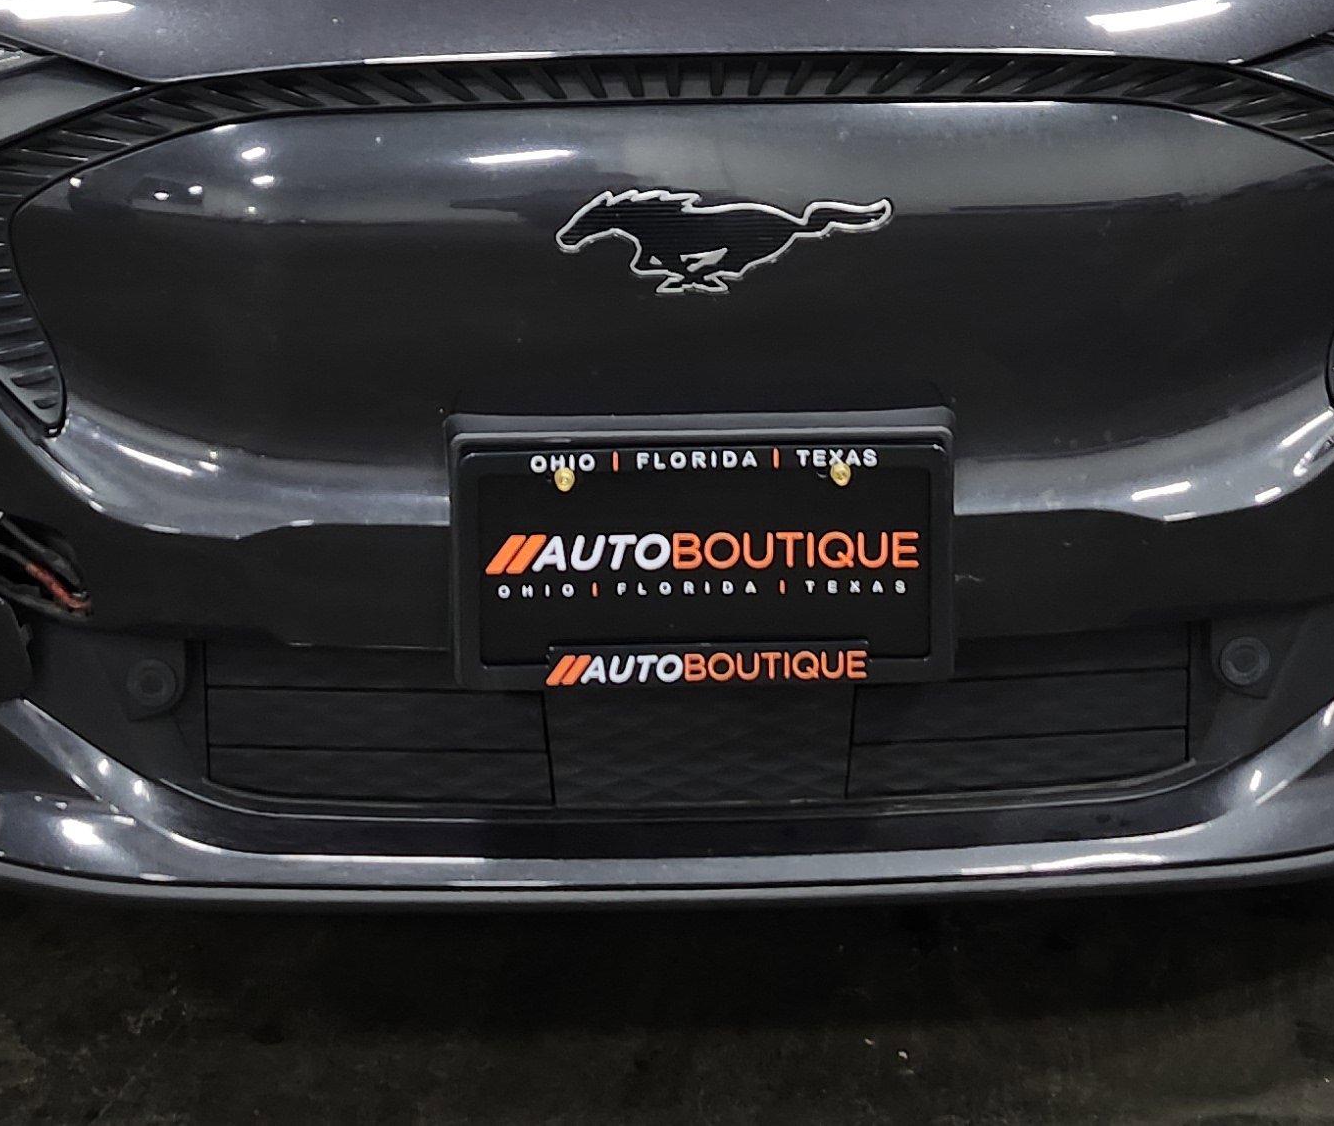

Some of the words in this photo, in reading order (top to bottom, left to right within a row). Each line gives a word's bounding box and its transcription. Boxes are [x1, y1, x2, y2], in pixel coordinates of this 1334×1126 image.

[530, 453, 596, 474] OHIO
[636, 450, 758, 470] FLORIDA
[796, 448, 878, 468] TEXAS
[497, 583, 575, 599] OHIO
[616, 580, 757, 596] FLORIDA
[804, 579, 906, 594] TEXAS
